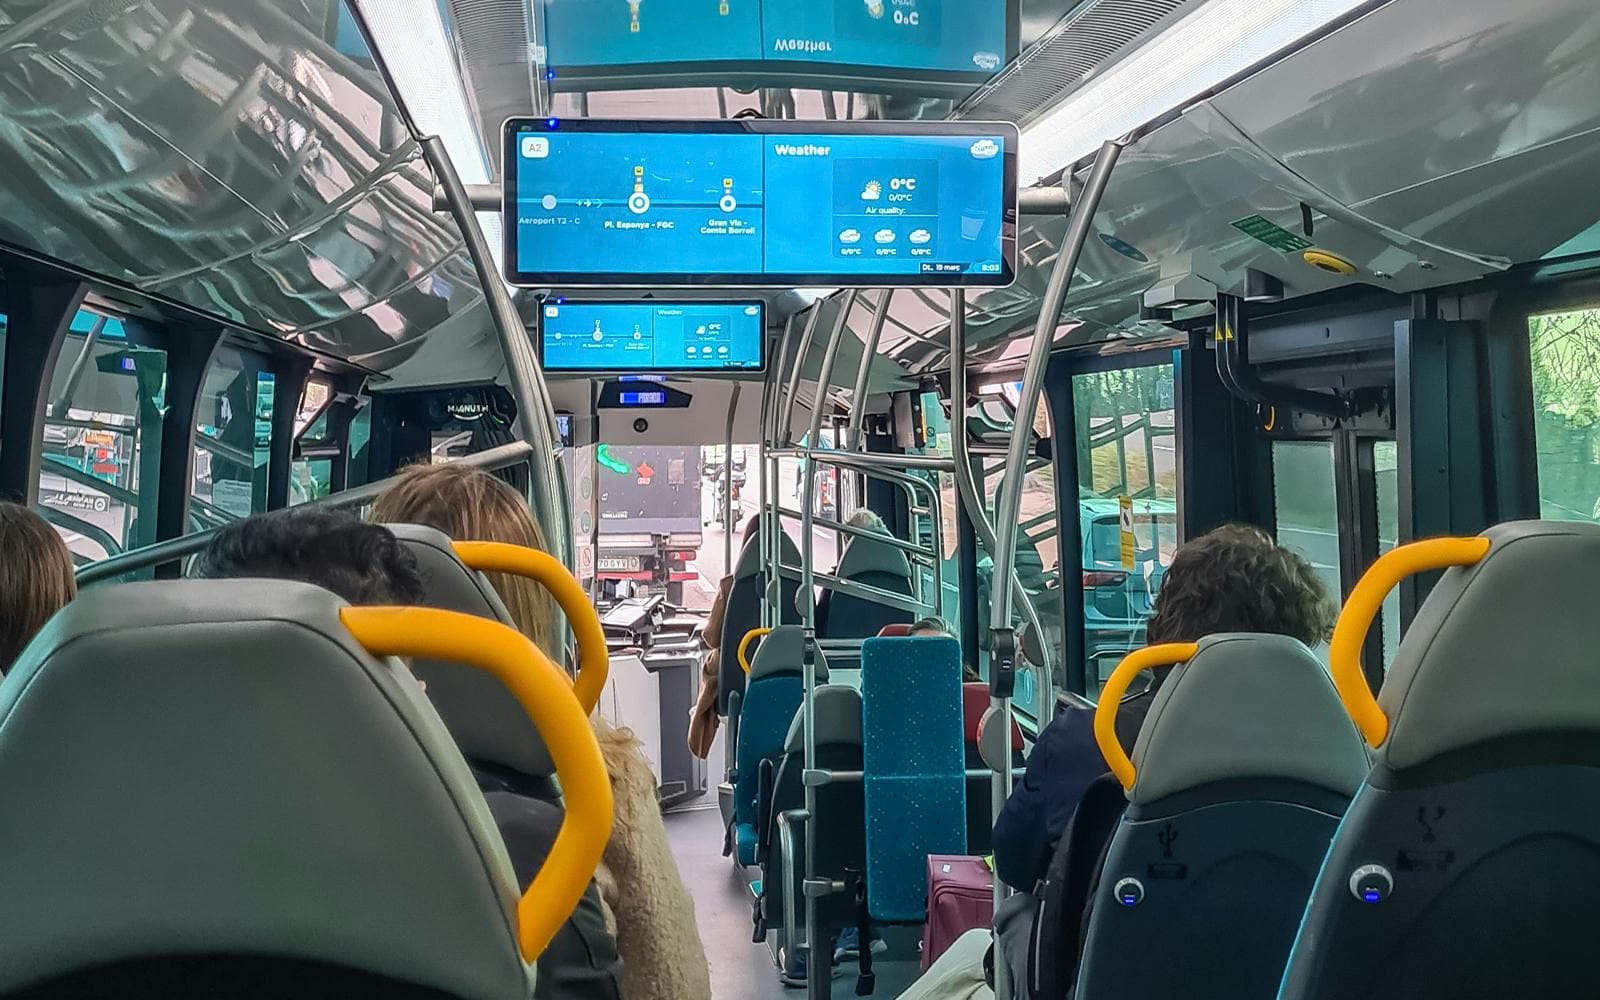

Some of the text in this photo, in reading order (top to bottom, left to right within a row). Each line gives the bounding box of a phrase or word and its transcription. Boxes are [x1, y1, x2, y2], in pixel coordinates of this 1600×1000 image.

[774, 144, 831, 156] Weather
[890, 178, 916, 190] 0°C
[865, 206, 907, 215] Air quality:
[519, 217, 555, 226] Aeroport
[574, 217, 581, 225] C
[616, 221, 650, 231] Espanya
[657, 221, 675, 229] FGC
